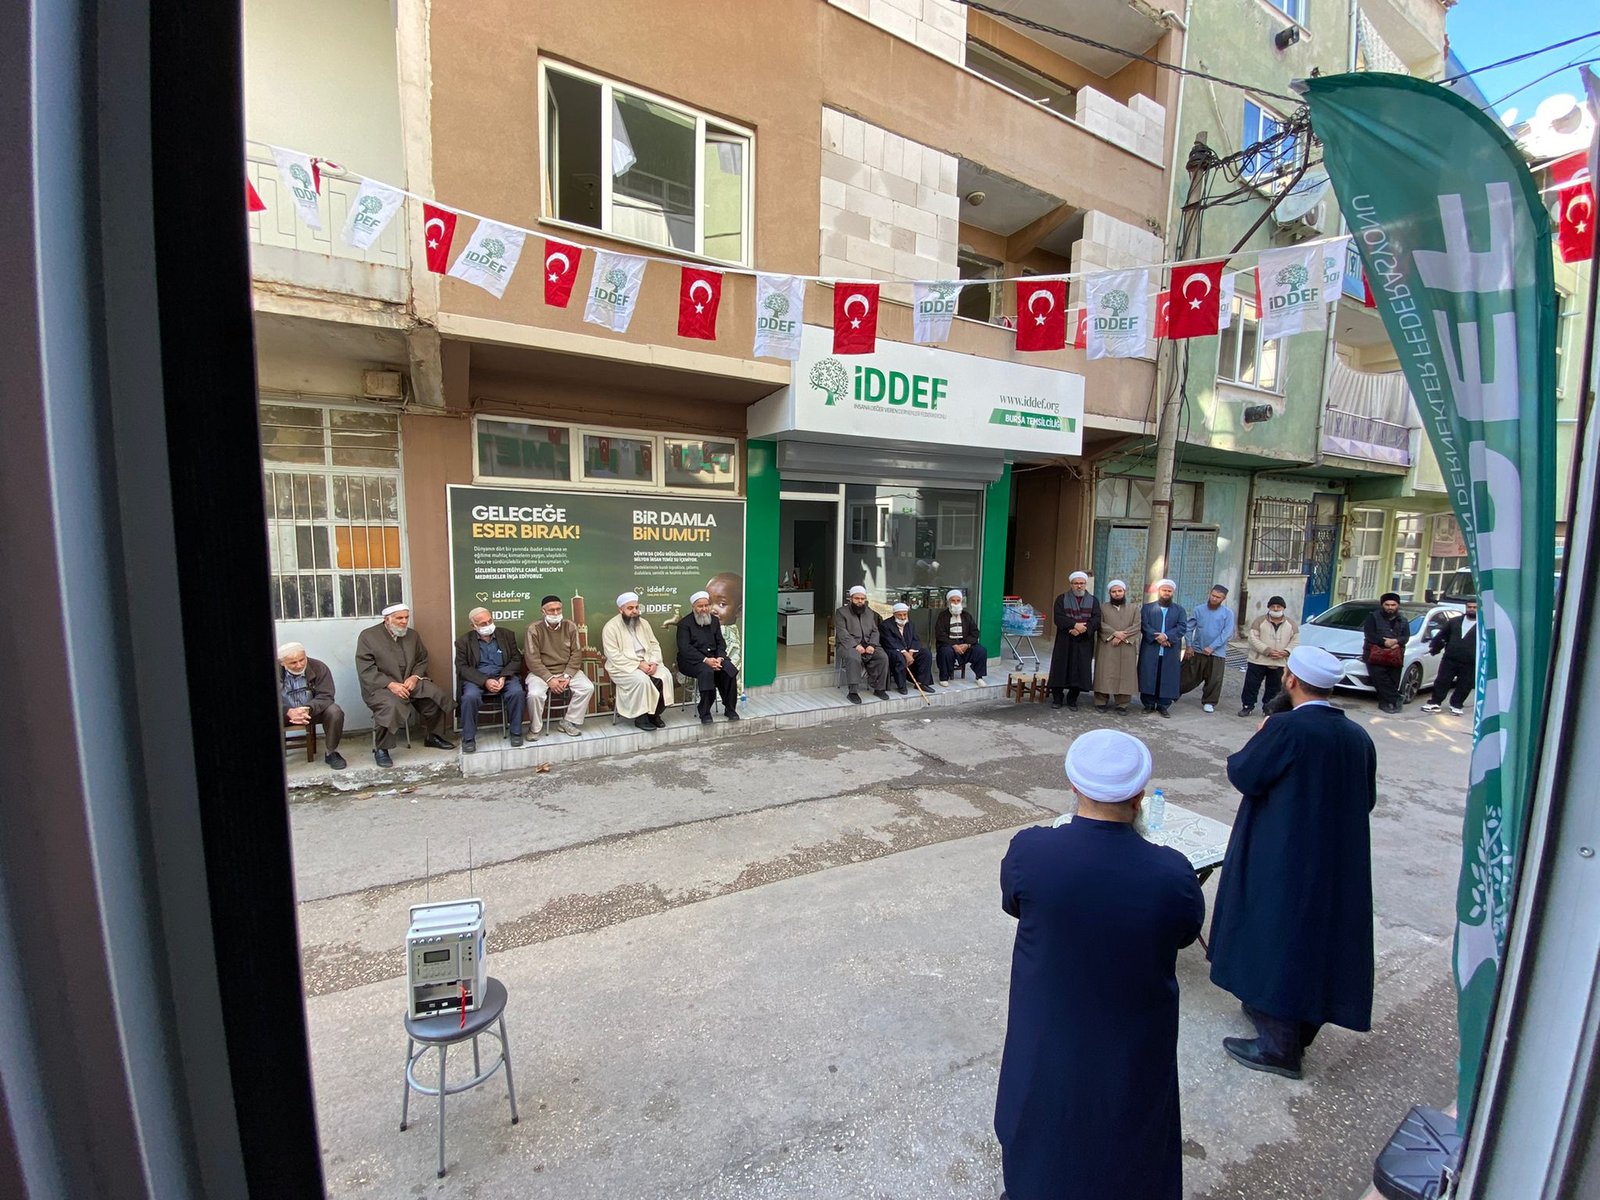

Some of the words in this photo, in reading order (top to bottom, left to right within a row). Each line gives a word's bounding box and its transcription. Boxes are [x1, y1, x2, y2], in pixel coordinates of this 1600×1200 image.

[1000, 395, 1060, 414] www.iddef.org
[1005, 414, 1026, 424] BURSA
[472, 504, 566, 522] GELECEĞE
[660, 511, 717, 527] DAMLA
[472, 523, 518, 538] ESER
[521, 525, 580, 539] BIRAK!
[662, 527, 710, 542] UMUT!
[492, 590, 531, 600] iddef.org
[647, 585, 677, 595] iddef.org
